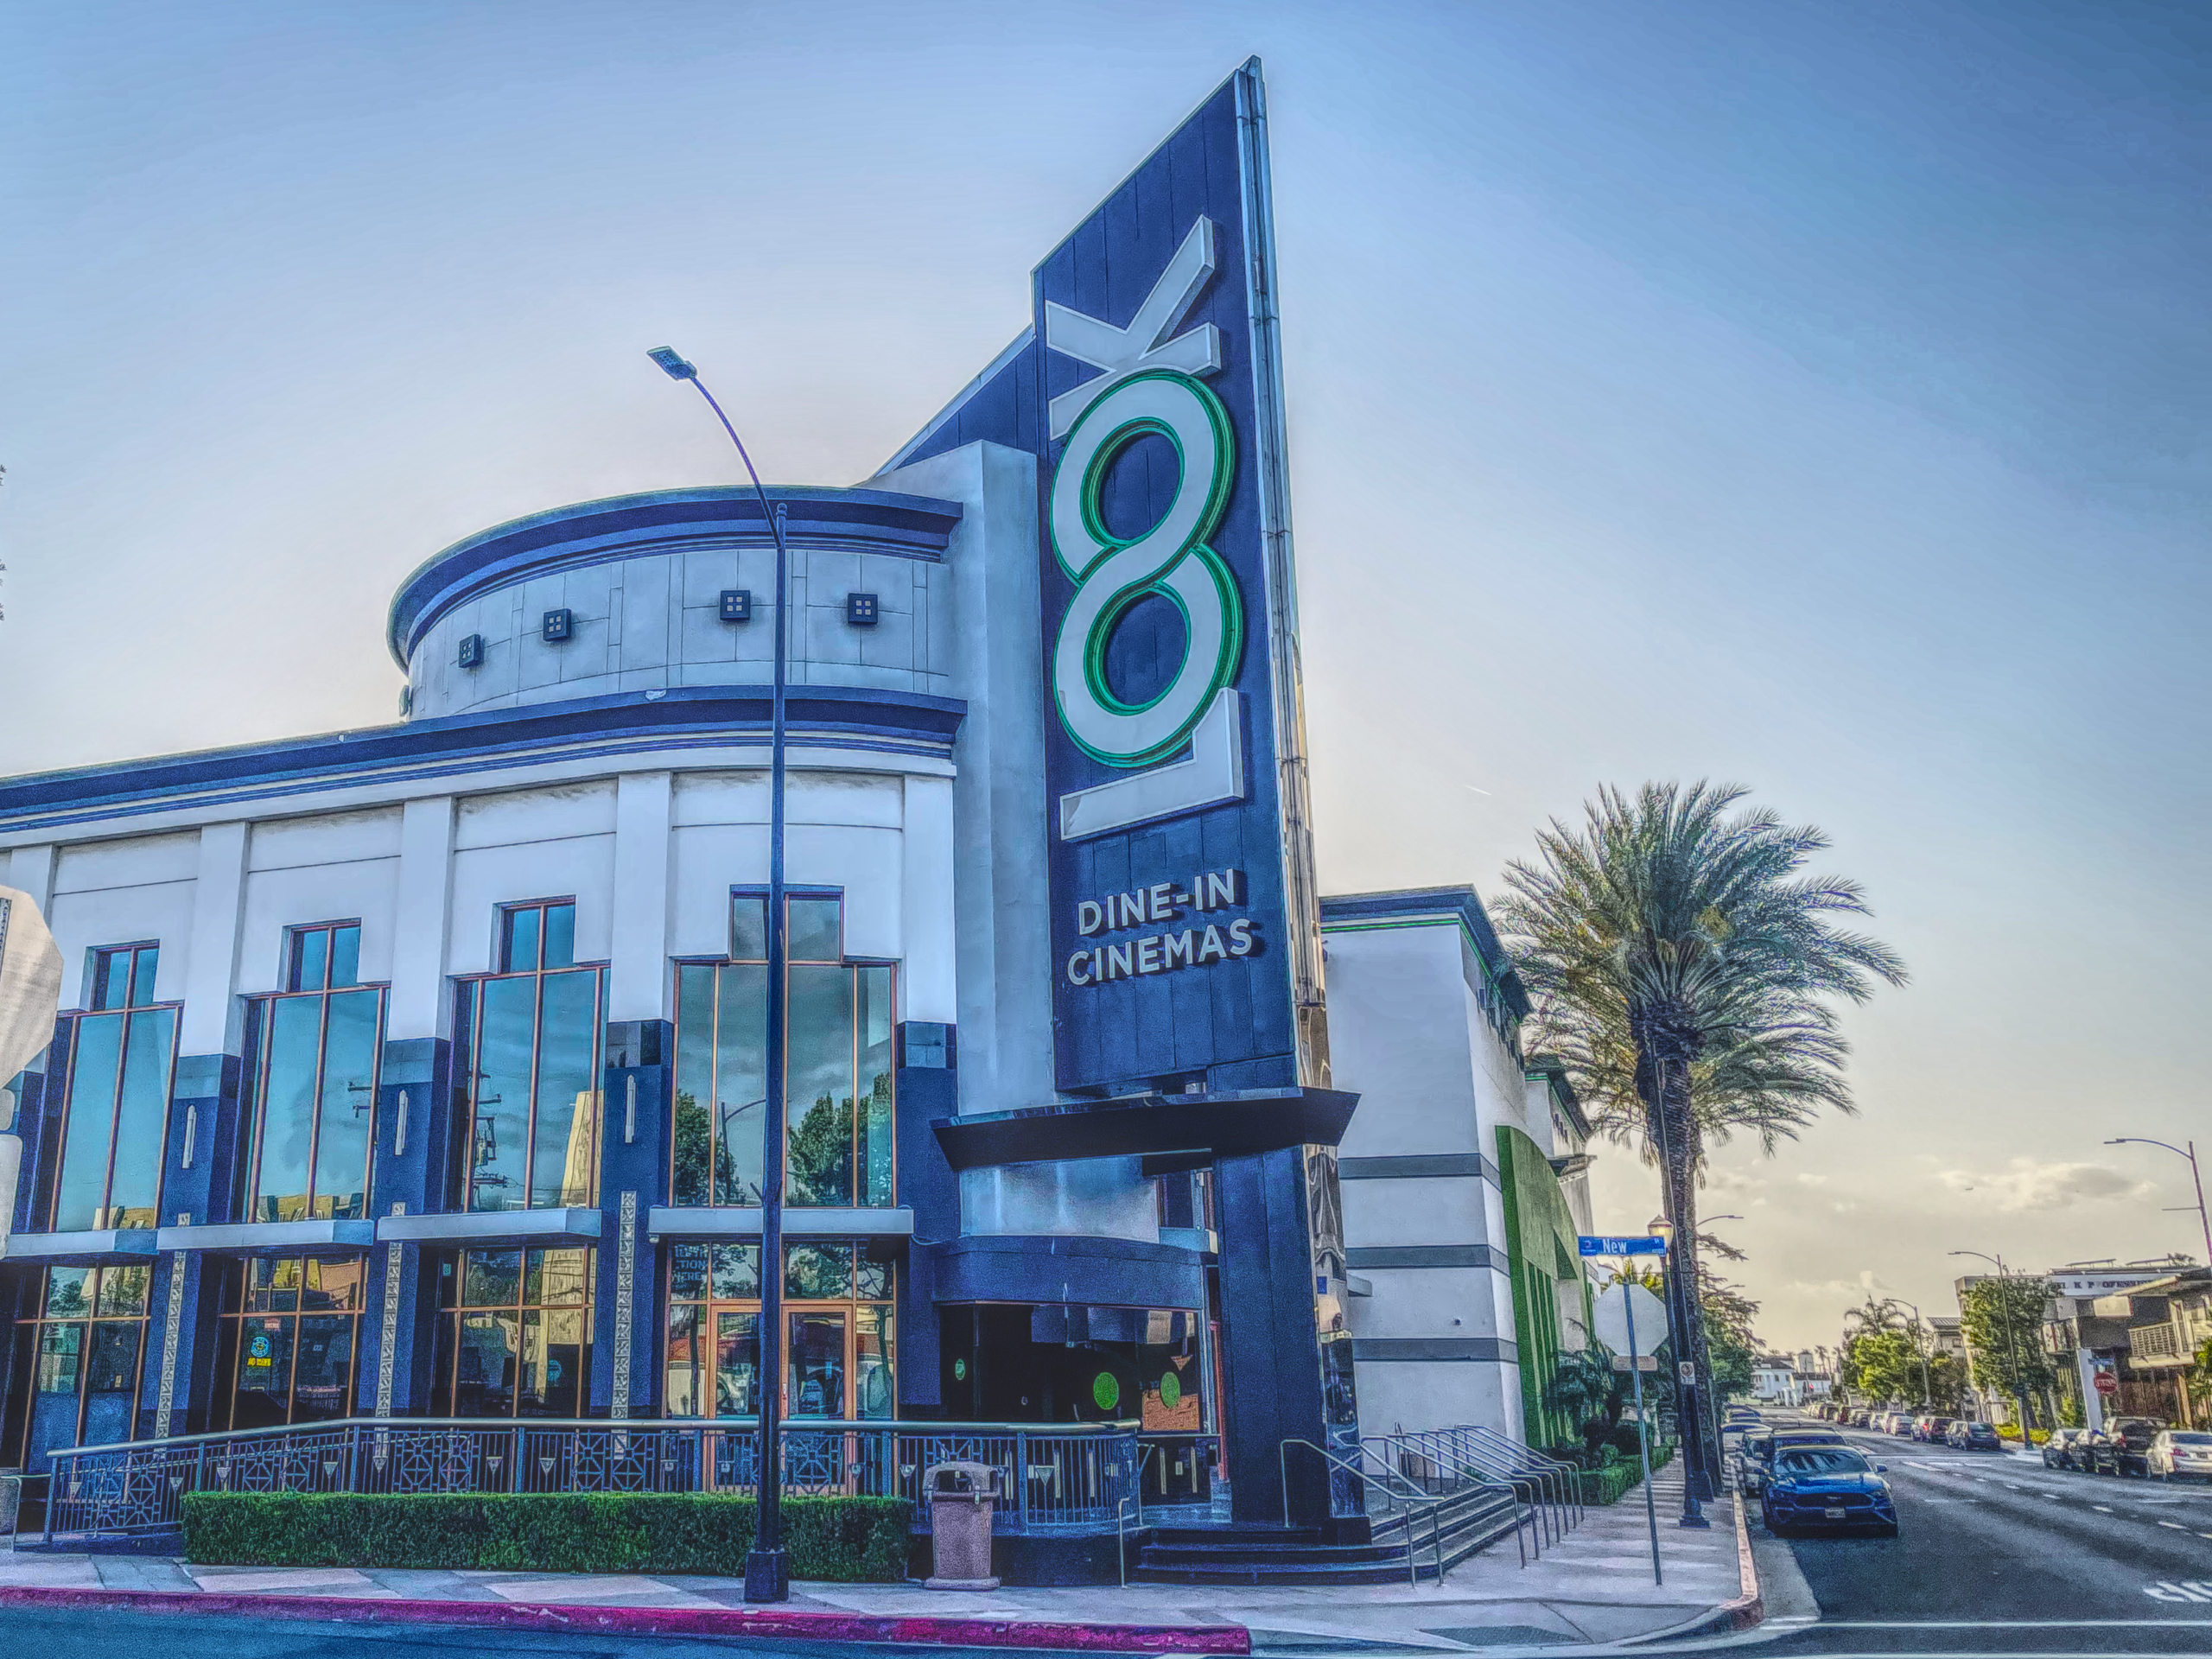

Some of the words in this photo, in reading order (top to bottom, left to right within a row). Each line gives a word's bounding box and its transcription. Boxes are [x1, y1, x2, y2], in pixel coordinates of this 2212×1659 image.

[1077, 868, 1236, 935] DINE-IN
[1067, 918, 1253, 985] CINEMAS
[1602, 1238, 1627, 1254] New
